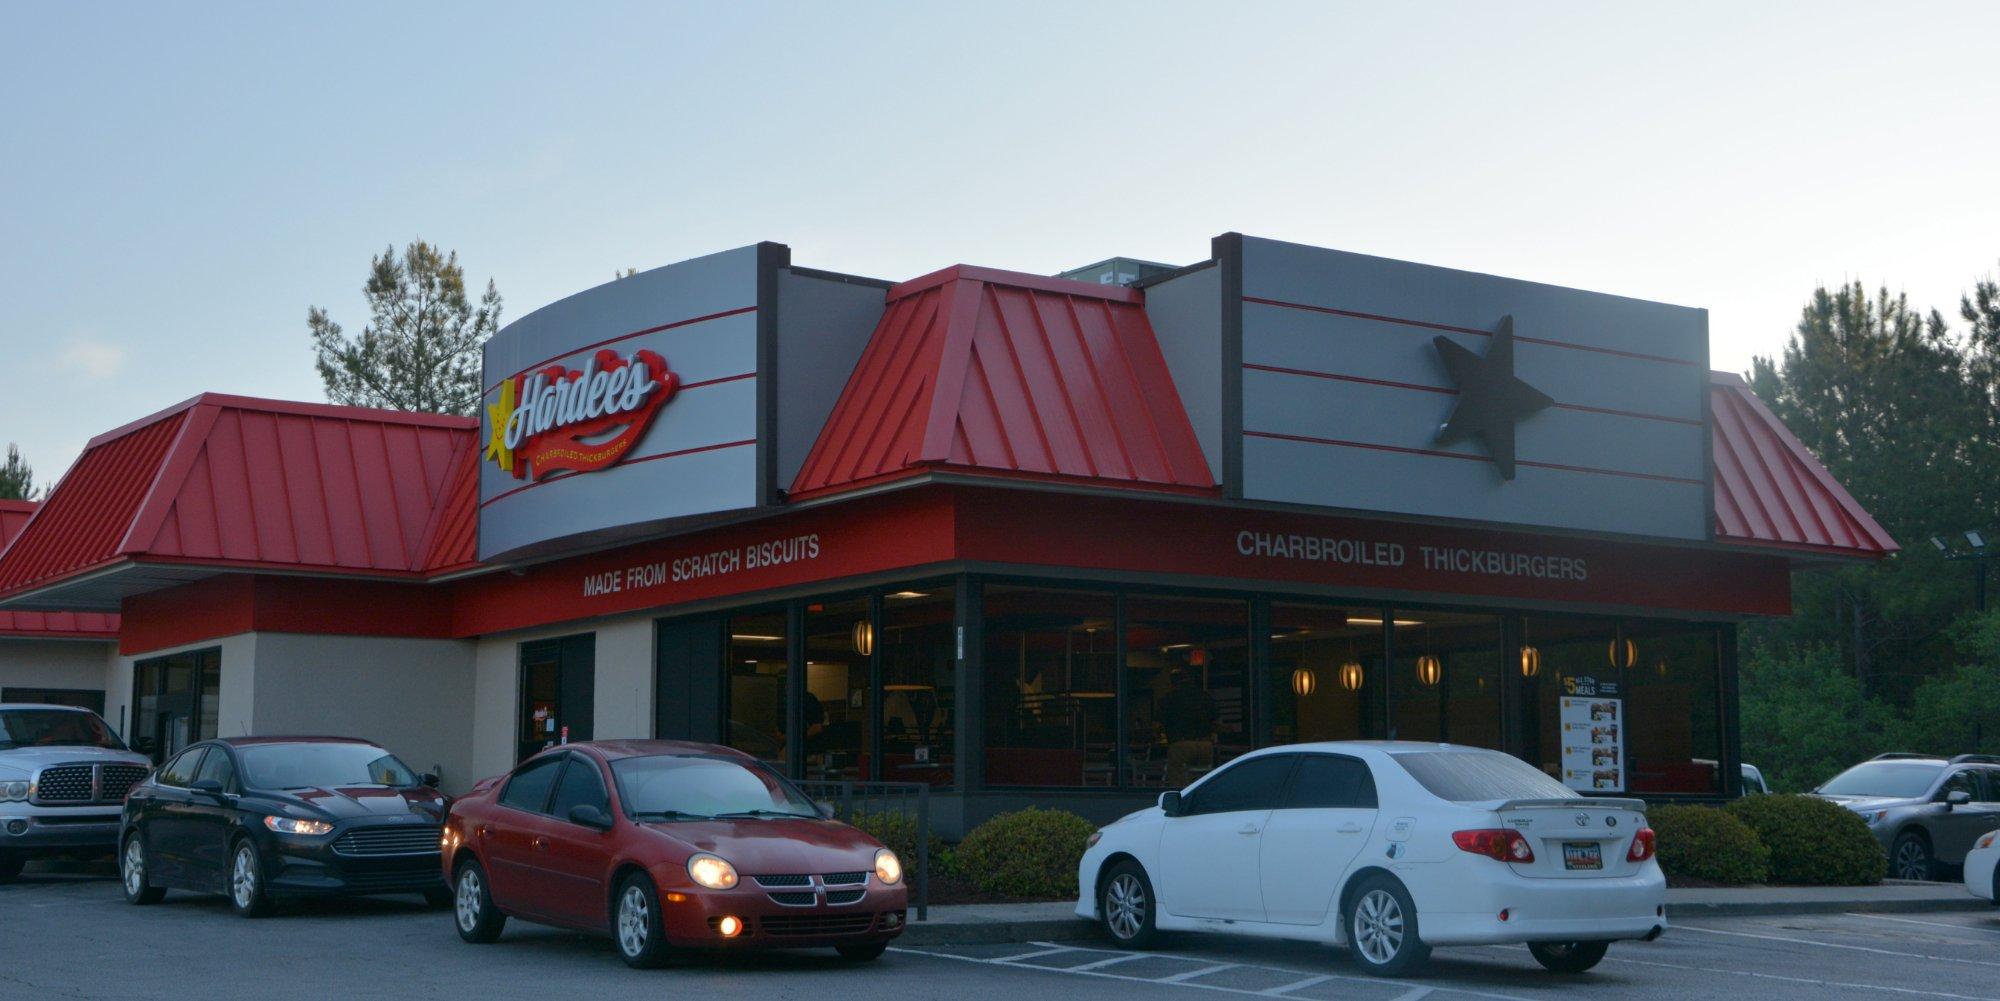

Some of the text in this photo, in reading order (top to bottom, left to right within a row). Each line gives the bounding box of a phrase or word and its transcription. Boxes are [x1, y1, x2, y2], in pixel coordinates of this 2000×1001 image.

[504, 353, 658, 450] Hardee's
[535, 439, 628, 466] CHARBROILED THICKBURGERS
[583, 533, 820, 597] MADE FROM SCRATCH BISCUITS
[1236, 530, 1588, 580] CHARBROILED THICKBURGERS
[1575, 685, 1596, 696] MEALS
